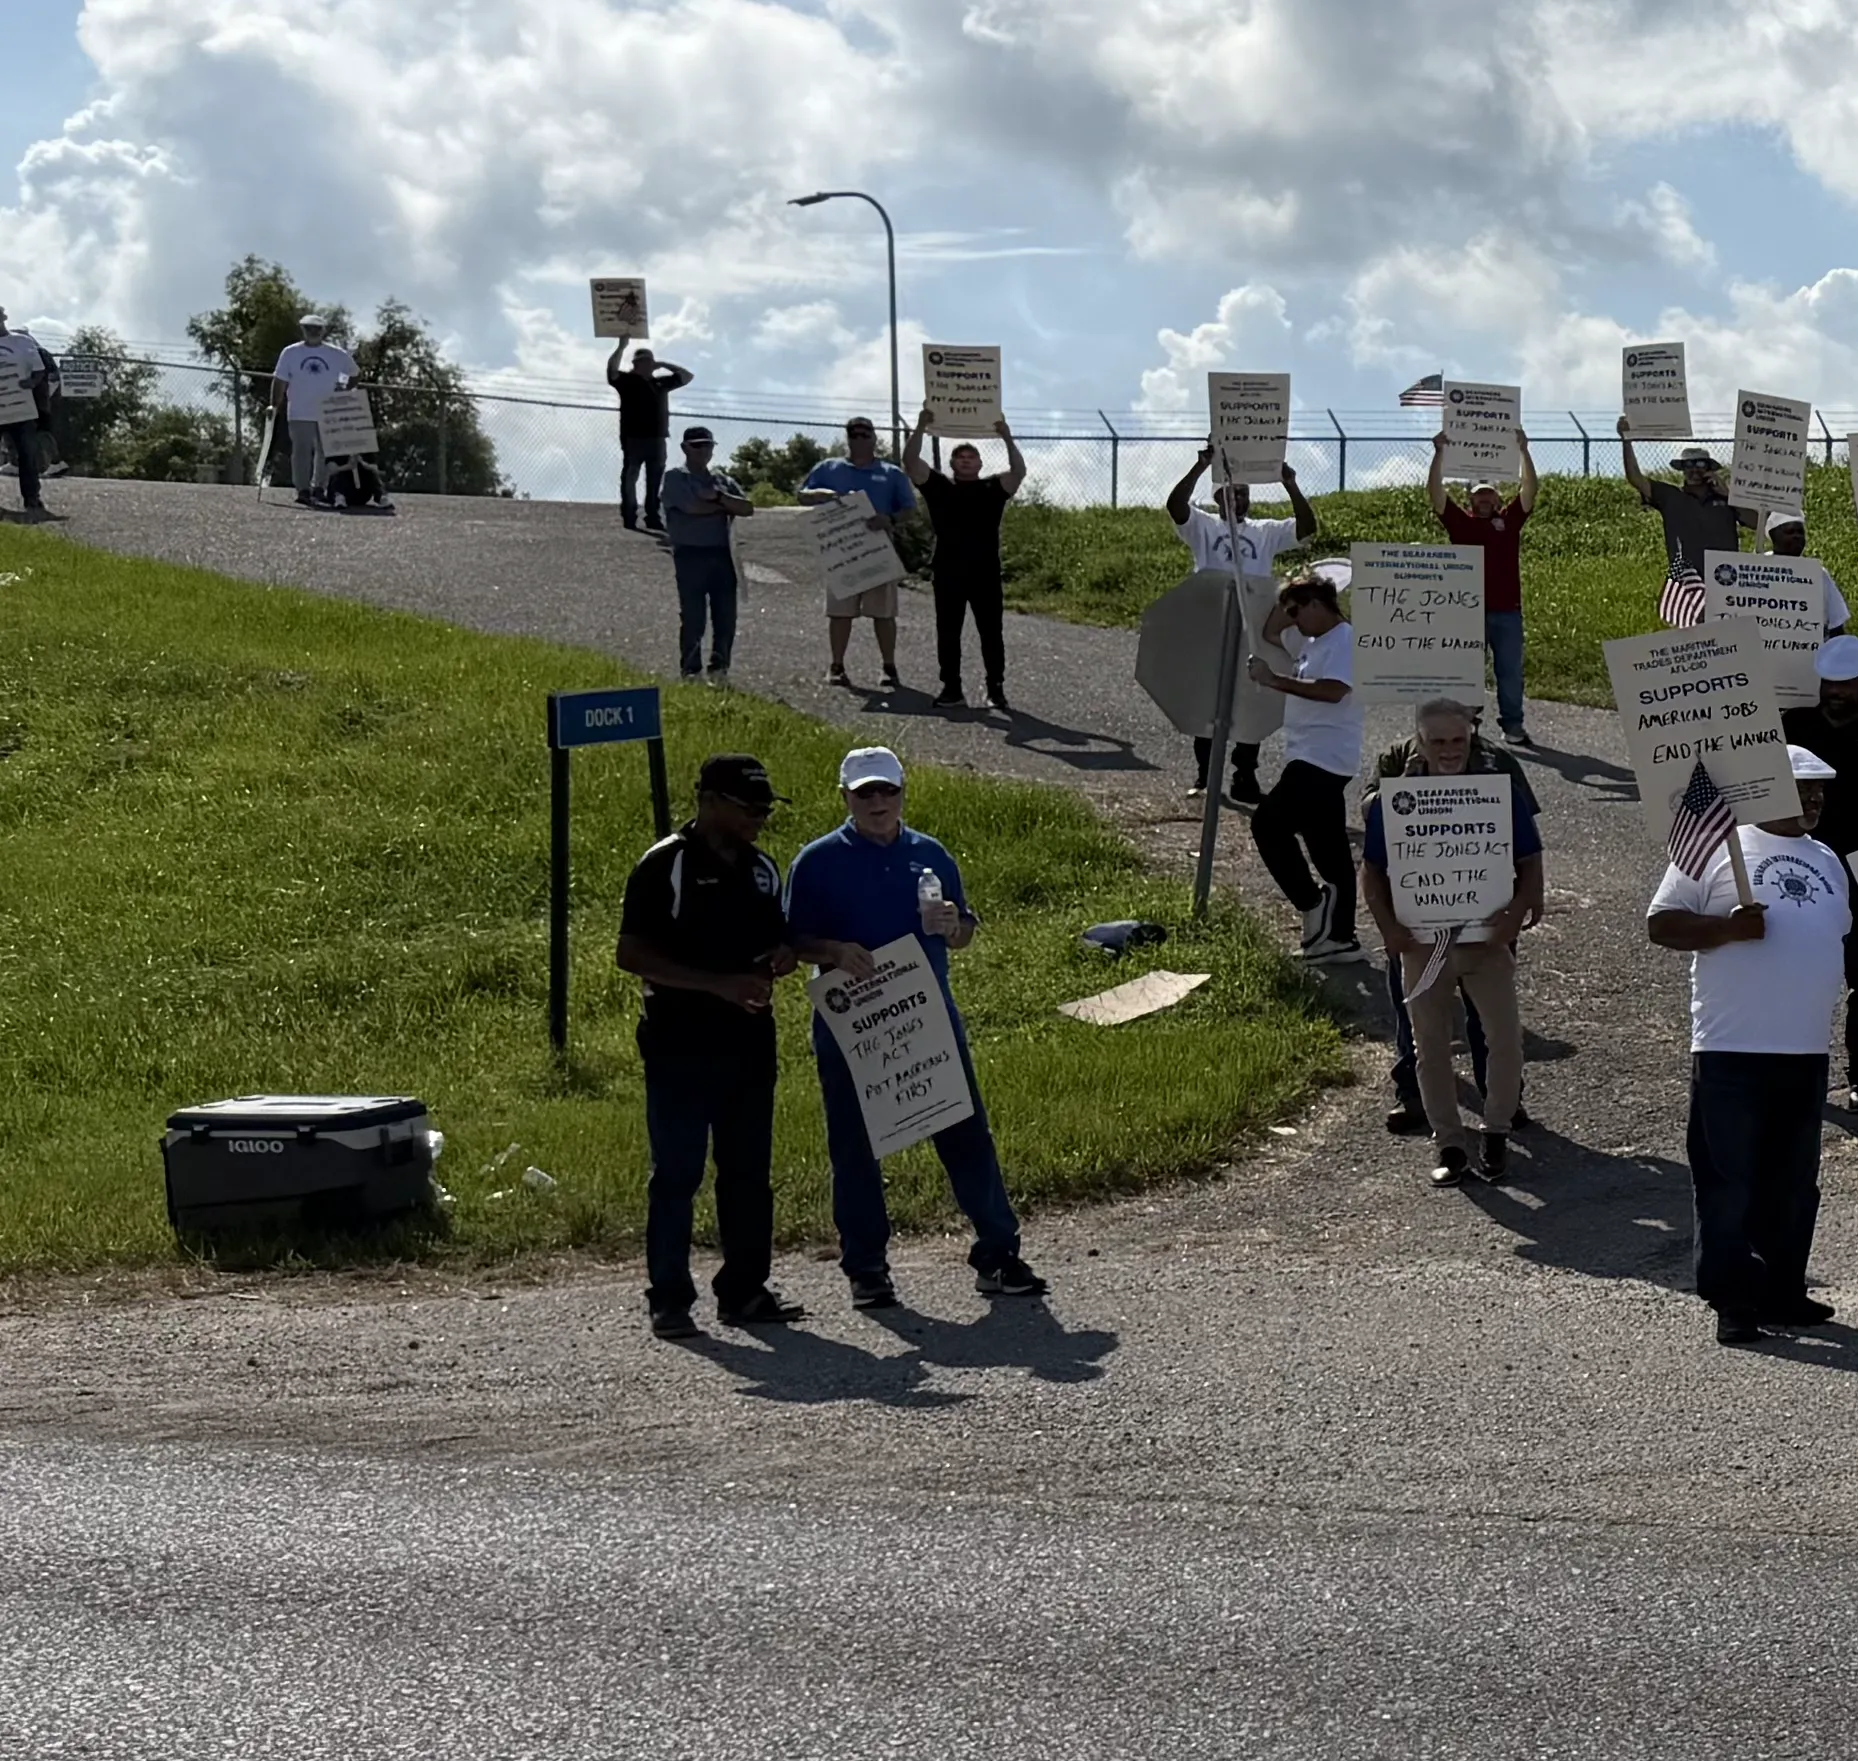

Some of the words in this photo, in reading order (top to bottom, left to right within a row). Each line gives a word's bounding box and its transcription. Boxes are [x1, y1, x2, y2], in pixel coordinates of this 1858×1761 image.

[1746, 424, 1798, 442] SUPPORTS
[1738, 563, 1794, 575] SEAFARERS
[1357, 586, 1410, 606] THE
[1419, 590, 1480, 609] JONES
[1725, 595, 1808, 611] SUPPORTS
[1390, 607, 1436, 624] ACT
[1792, 621, 1820, 631] ACT
[1357, 634, 1396, 650] END
[1401, 637, 1436, 650] THE
[1633, 657, 1673, 672] TRADES
[1673, 644, 1738, 664] DEPARTMENT
[1649, 647, 1669, 659] THE
[1639, 672, 1750, 706] SUPPORTS
[585, 707, 624, 728] DOCK
[626, 706, 634, 724] 1
[1638, 706, 1713, 731] AMERICAN
[1720, 701, 1758, 721] JOBS
[1652, 744, 1691, 764] END
[1692, 735, 1724, 755] THE
[1729, 728, 1784, 751] WAIVER
[1416, 788, 1479, 797] SEAFARERS
[1417, 797, 1501, 807] INTERNATIONAL
[1418, 807, 1453, 815] UNION
[1404, 822, 1496, 837] SUPPORTS
[1392, 841, 1427, 860] THE
[1434, 841, 1481, 859] JONES
[1484, 841, 1511, 857] ACT
[1400, 870, 1444, 888] END
[1452, 868, 1488, 883] THE
[849, 961, 920, 998] INTERNATIONAL
[852, 991, 928, 1034] SUPPORTS
[850, 1036, 881, 1061] THE
[884, 1016, 925, 1046] JONES
[882, 1041, 913, 1069] ACT
[865, 1076, 892, 1099] PUT
[896, 1077, 935, 1106] FIRST
